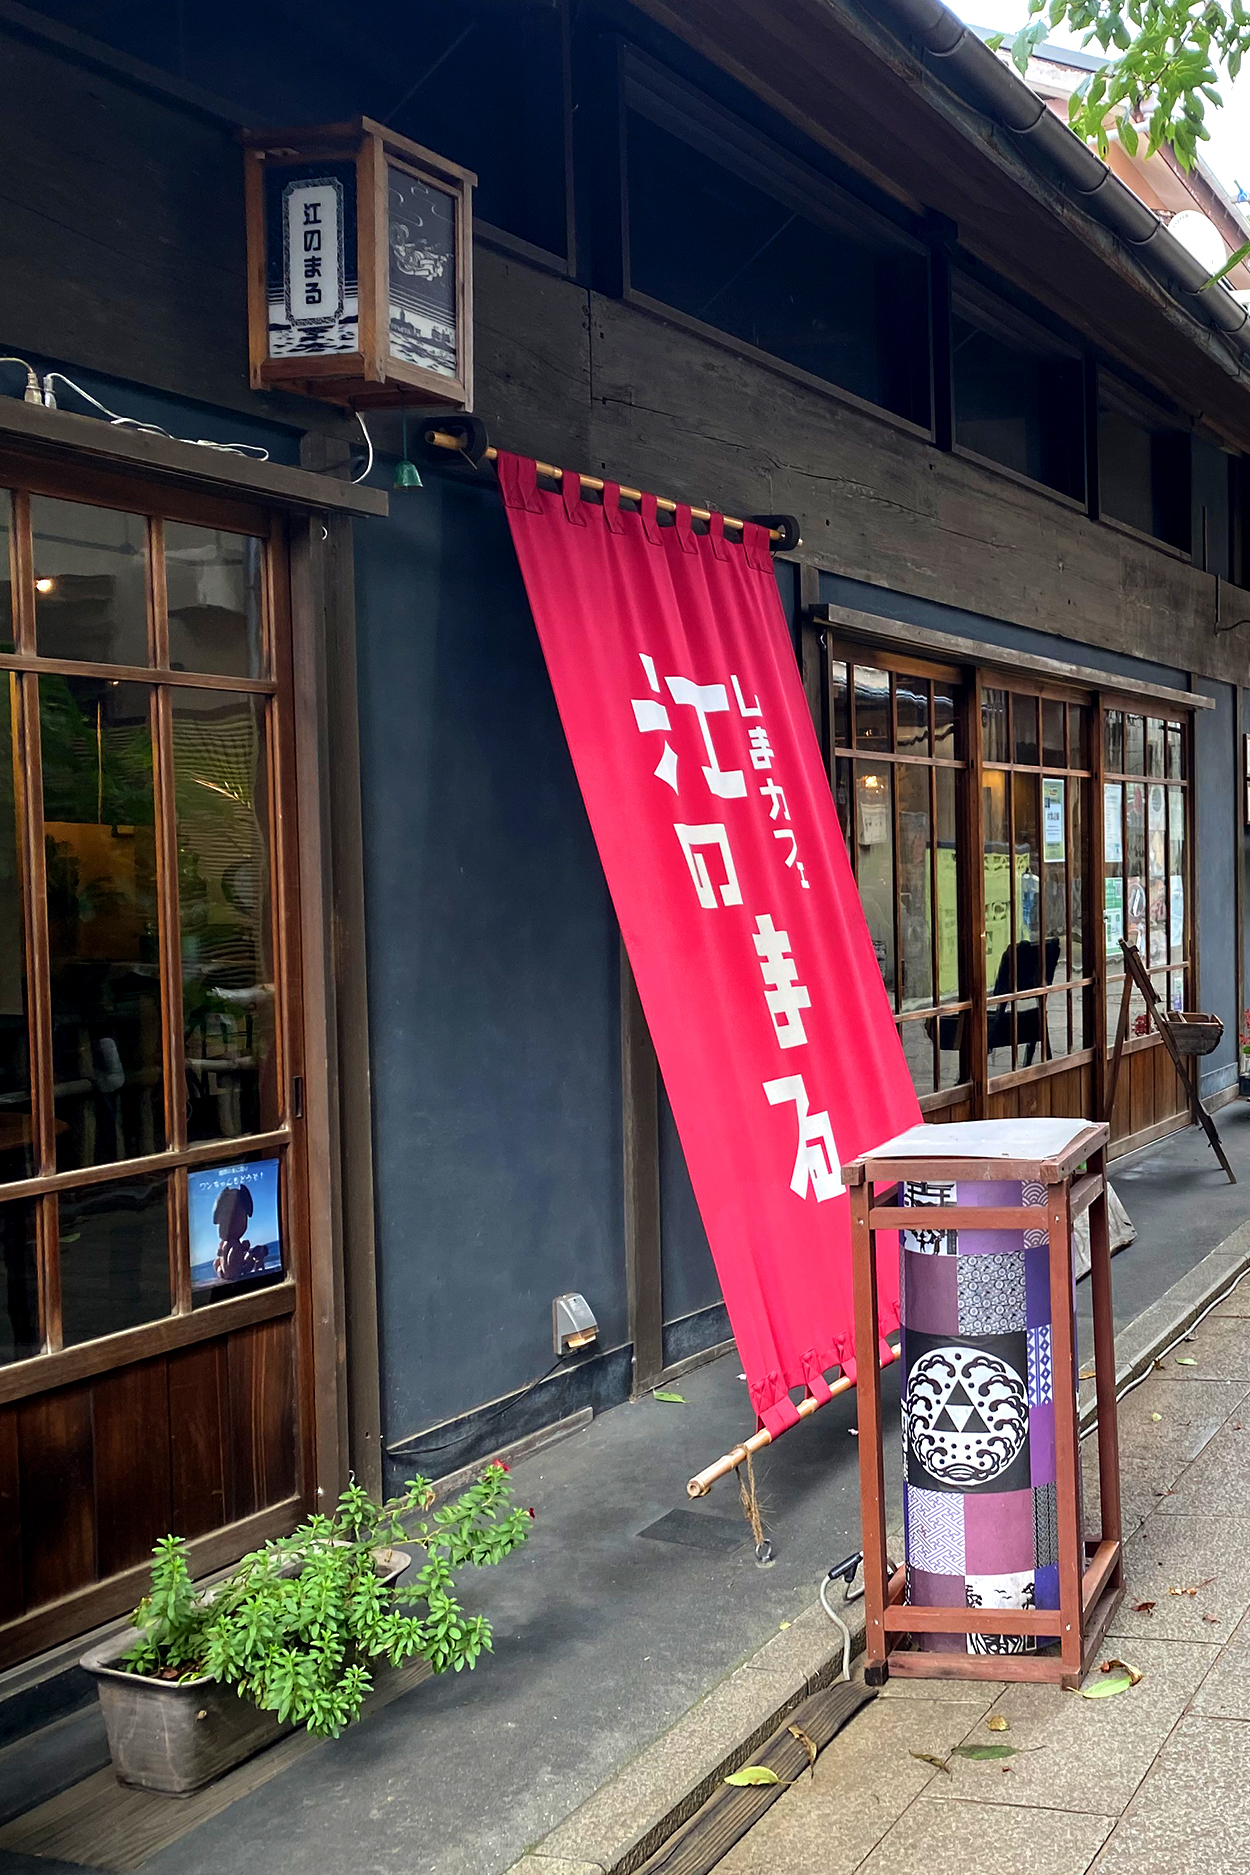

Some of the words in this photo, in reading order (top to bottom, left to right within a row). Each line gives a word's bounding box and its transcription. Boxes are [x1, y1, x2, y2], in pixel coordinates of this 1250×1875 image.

[303, 203, 322, 305] 江のまる
[731, 674, 811, 889] しまカフェ
[631, 653, 846, 1203] 江のまる
